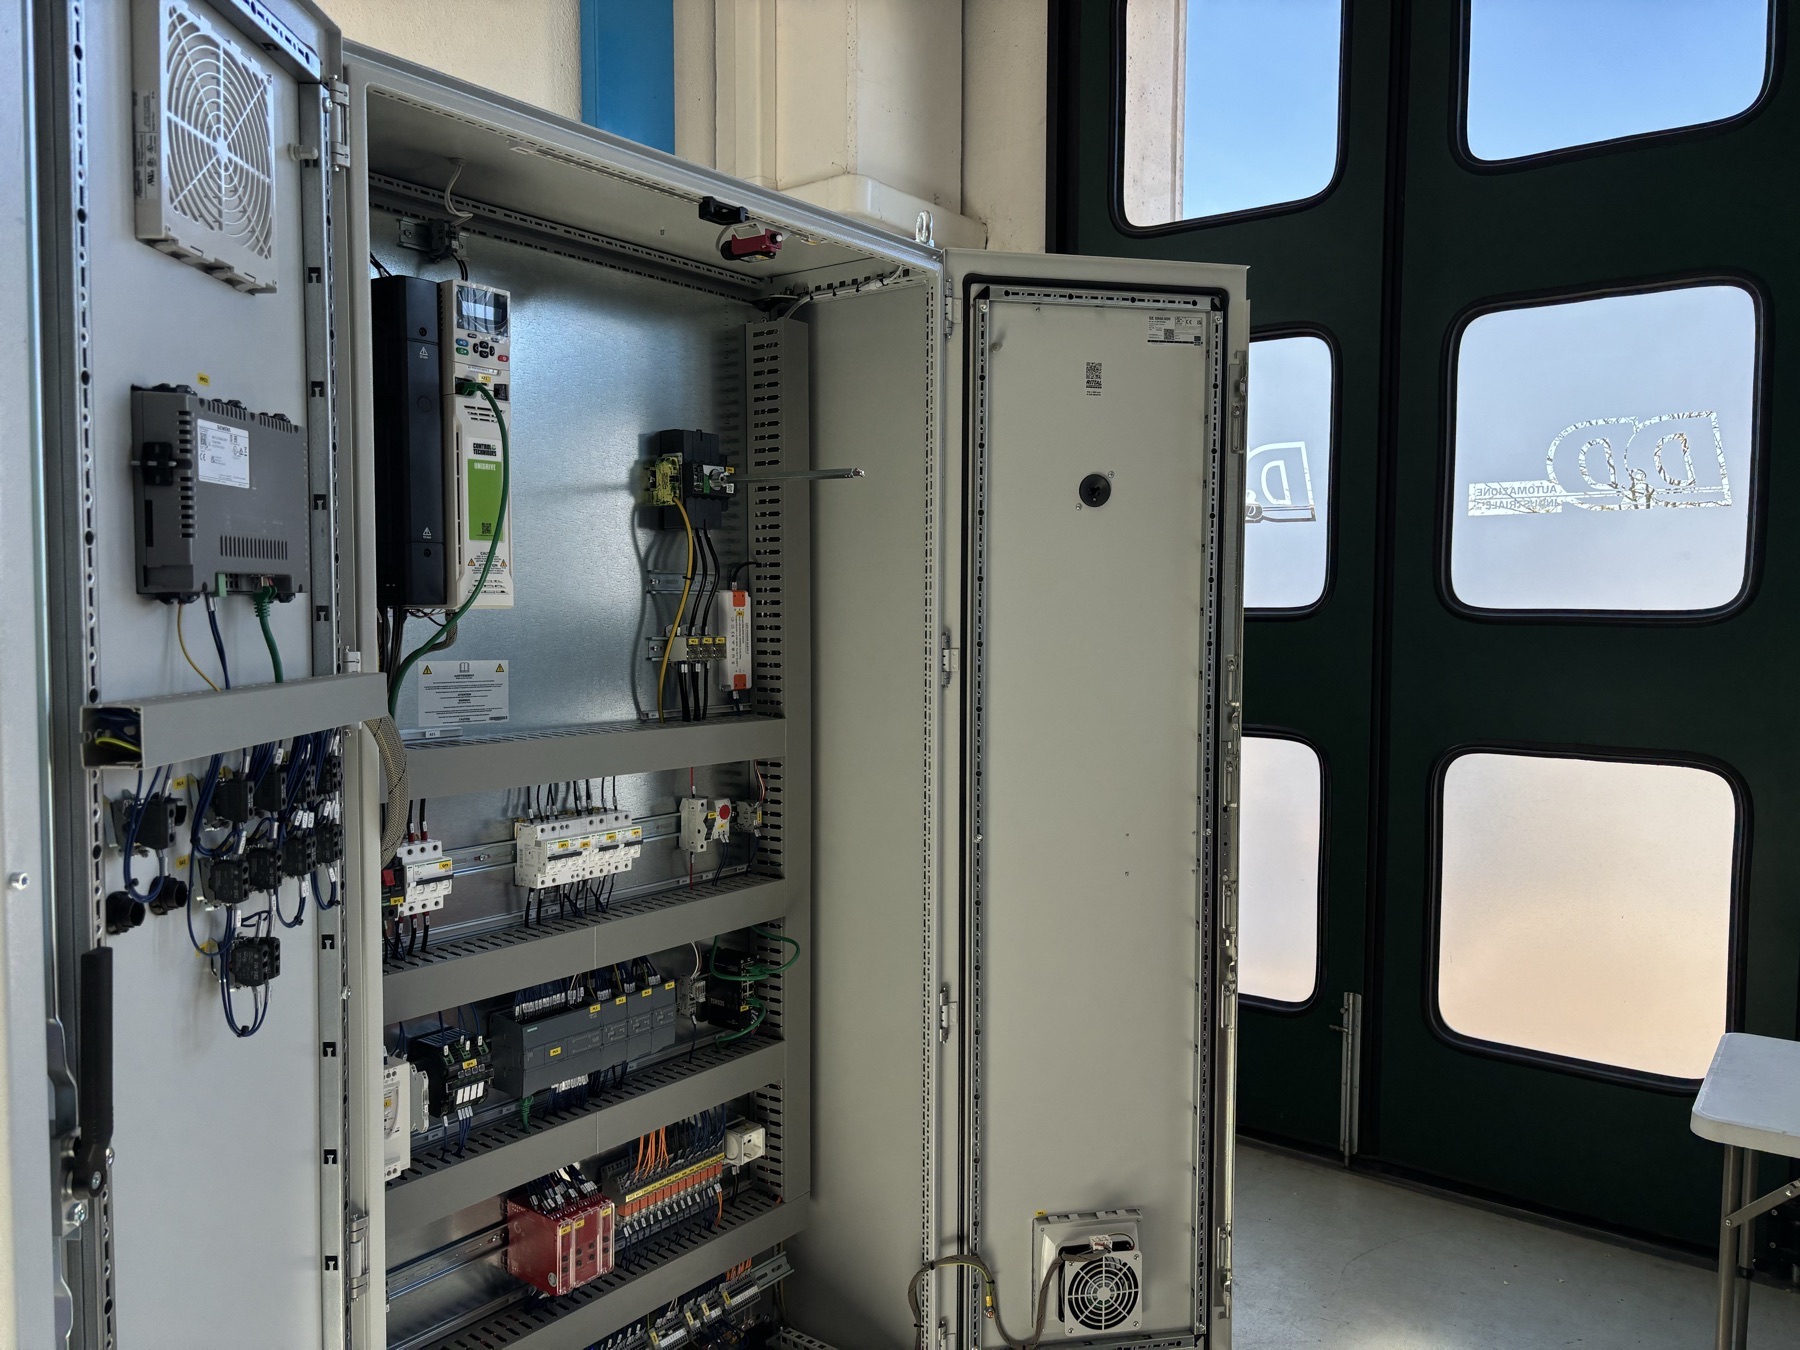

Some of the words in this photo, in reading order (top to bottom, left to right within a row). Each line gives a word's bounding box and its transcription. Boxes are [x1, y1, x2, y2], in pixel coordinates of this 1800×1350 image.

[216, 424, 232, 432] SIEMENS
[472, 448, 497, 456] TECHNIQUES
[474, 462, 496, 471] UNIDRIVE
